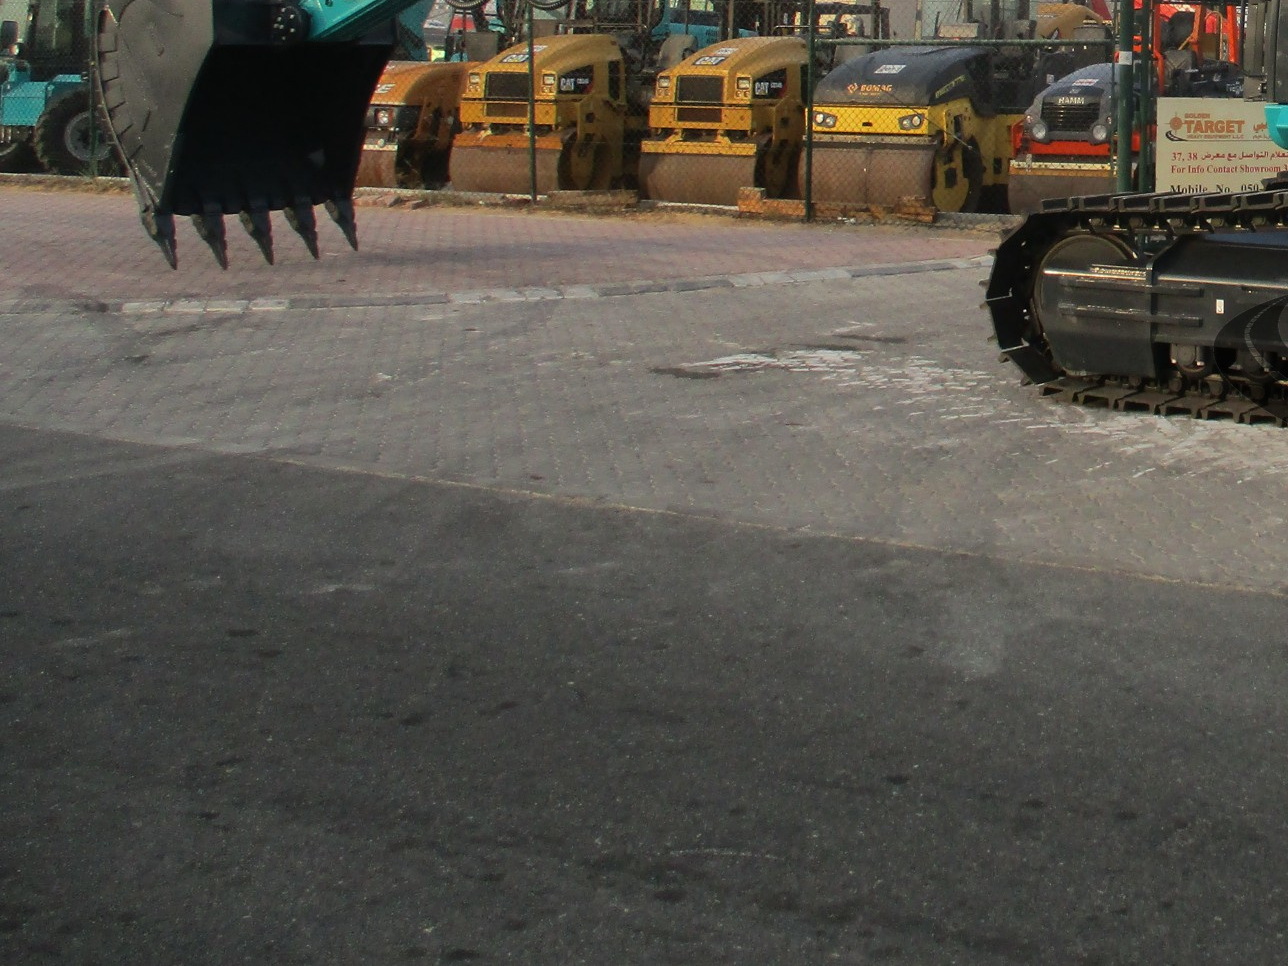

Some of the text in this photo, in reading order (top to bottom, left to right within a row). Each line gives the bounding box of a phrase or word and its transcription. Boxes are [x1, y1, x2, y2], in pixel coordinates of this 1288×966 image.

[694, 56, 726, 65] CAT
[560, 77, 575, 92] CAT
[755, 81, 769, 95] CAT
[1058, 96, 1085, 104] HAMM
[1184, 120, 1245, 133] TARGET
[1187, 152, 1198, 161] 38
[1227, 152, 1237, 161] مع
[1171, 165, 1186, 174] For
[1188, 165, 1205, 174] Info
[1206, 165, 1238, 174] Contact
[1240, 164, 1281, 173] Showroom
[1170, 184, 1208, 194] Mobile
[1216, 184, 1233, 194] No.
